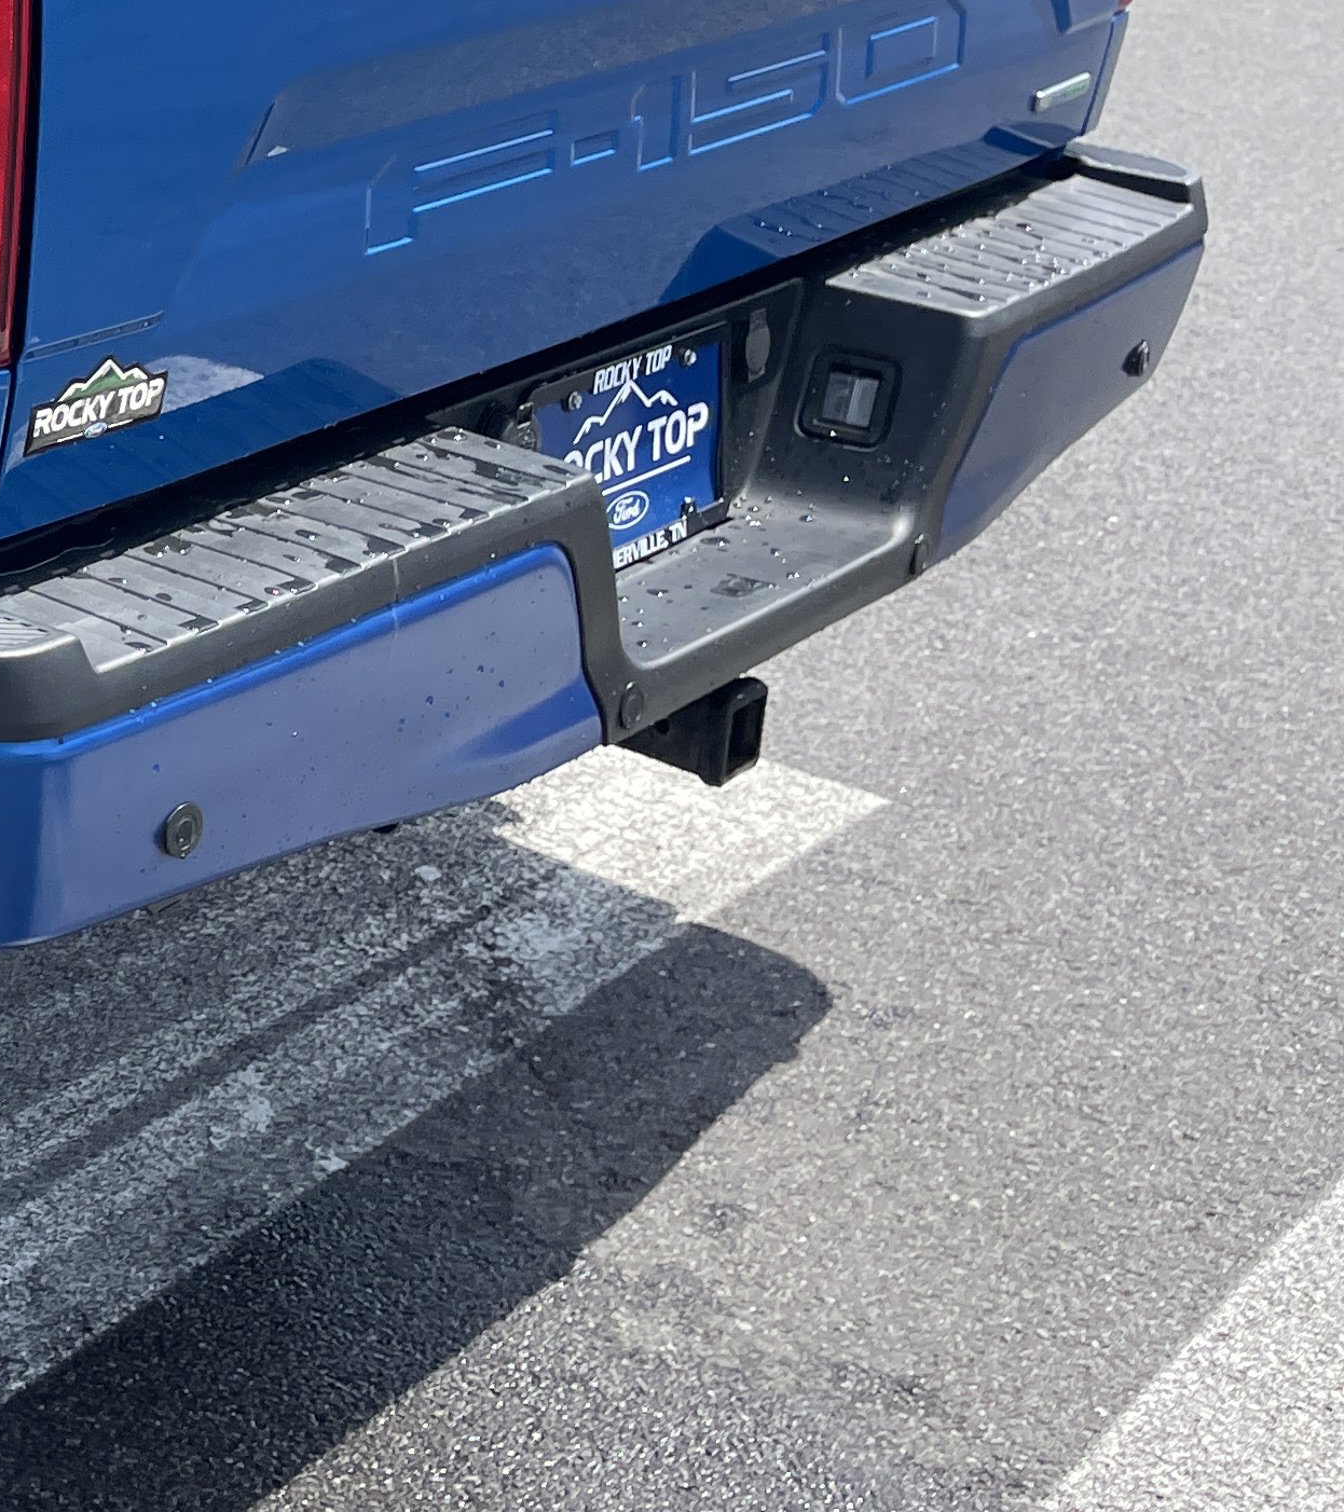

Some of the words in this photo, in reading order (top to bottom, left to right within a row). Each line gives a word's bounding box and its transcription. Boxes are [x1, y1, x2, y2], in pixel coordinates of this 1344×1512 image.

[593, 355, 643, 395] ROCKY
[645, 344, 673, 376] TOP
[33, 390, 116, 438] ROCKY
[118, 377, 165, 414] TOP
[563, 424, 643, 484] CKY
[647, 402, 709, 462] TOP
[613, 497, 641, 525] Ford
[669, 518, 688, 544] TN
